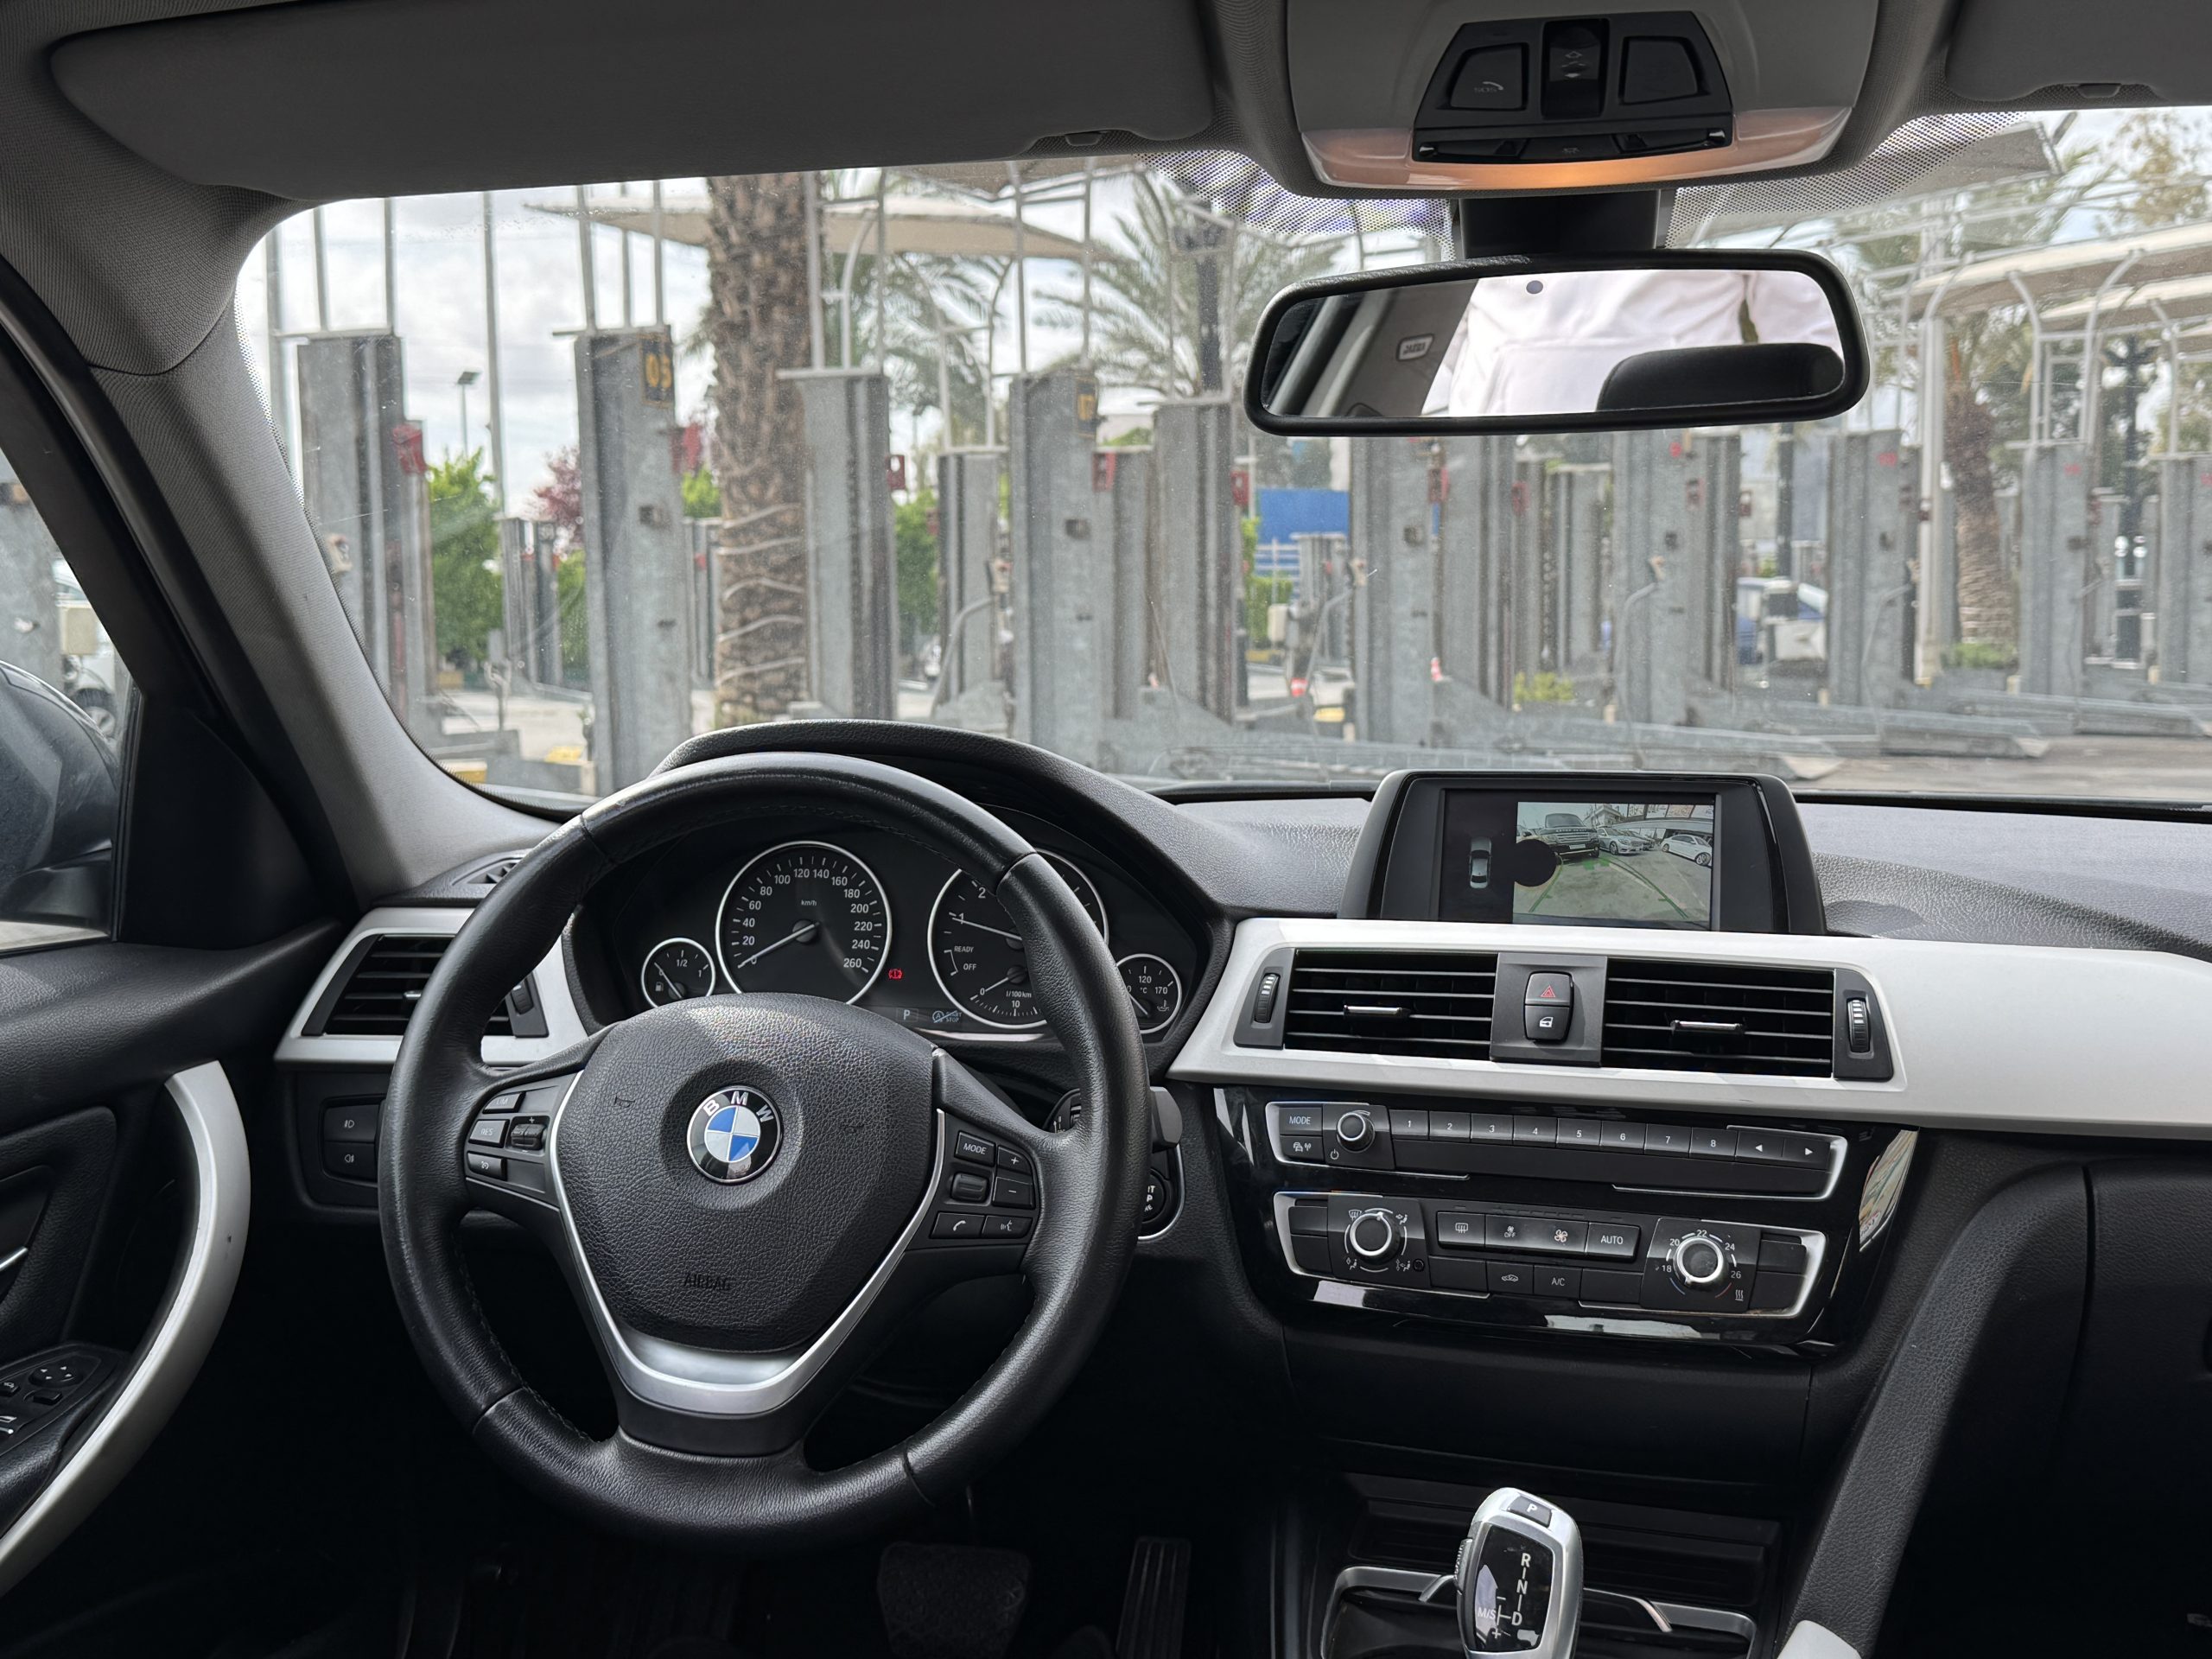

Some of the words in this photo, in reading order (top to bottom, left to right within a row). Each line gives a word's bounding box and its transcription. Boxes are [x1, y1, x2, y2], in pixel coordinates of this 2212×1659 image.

[793, 868, 810, 878] 120
[812, 869, 830, 879] 140
[774, 874, 791, 885] 100
[831, 876, 848, 886] 160
[760, 887, 772, 896] 80
[843, 888, 860, 899] 180
[977, 887, 986, 899] 2
[748, 900, 761, 910] 60
[850, 903, 869, 913] 200
[742, 918, 755, 927] 40
[854, 921, 873, 931] 220
[742, 936, 755, 945] 20
[851, 939, 870, 950] 240
[843, 957, 862, 968] 260
[1011, 1000, 1020, 1008] 10
[903, 1009, 911, 1020] P
[703, 1090, 774, 1122] BMW
[1289, 1116, 1312, 1125] MODE
[1446, 1122, 1452, 1131] 2
[1489, 1124, 1495, 1133] 3
[1576, 1129, 1582, 1138] 5
[1665, 1135, 1671, 1144] 7
[1710, 1139, 1716, 1147] 8
[963, 1142, 987, 1155] MODE
[1696, 1229, 1707, 1237] 22
[1600, 1235, 1624, 1244] AUTO
[1669, 1238, 1681, 1247] 20
[1725, 1243, 1735, 1251] 24
[1731, 1270, 1741, 1279] 26
[1551, 1277, 1566, 1287] A/C
[1526, 1503, 1537, 1512] P
[1521, 1553, 1531, 1567] R
[1516, 1579, 1528, 1595] N
[1477, 1606, 1497, 1619] M/S
[1512, 1611, 1522, 1626] D
